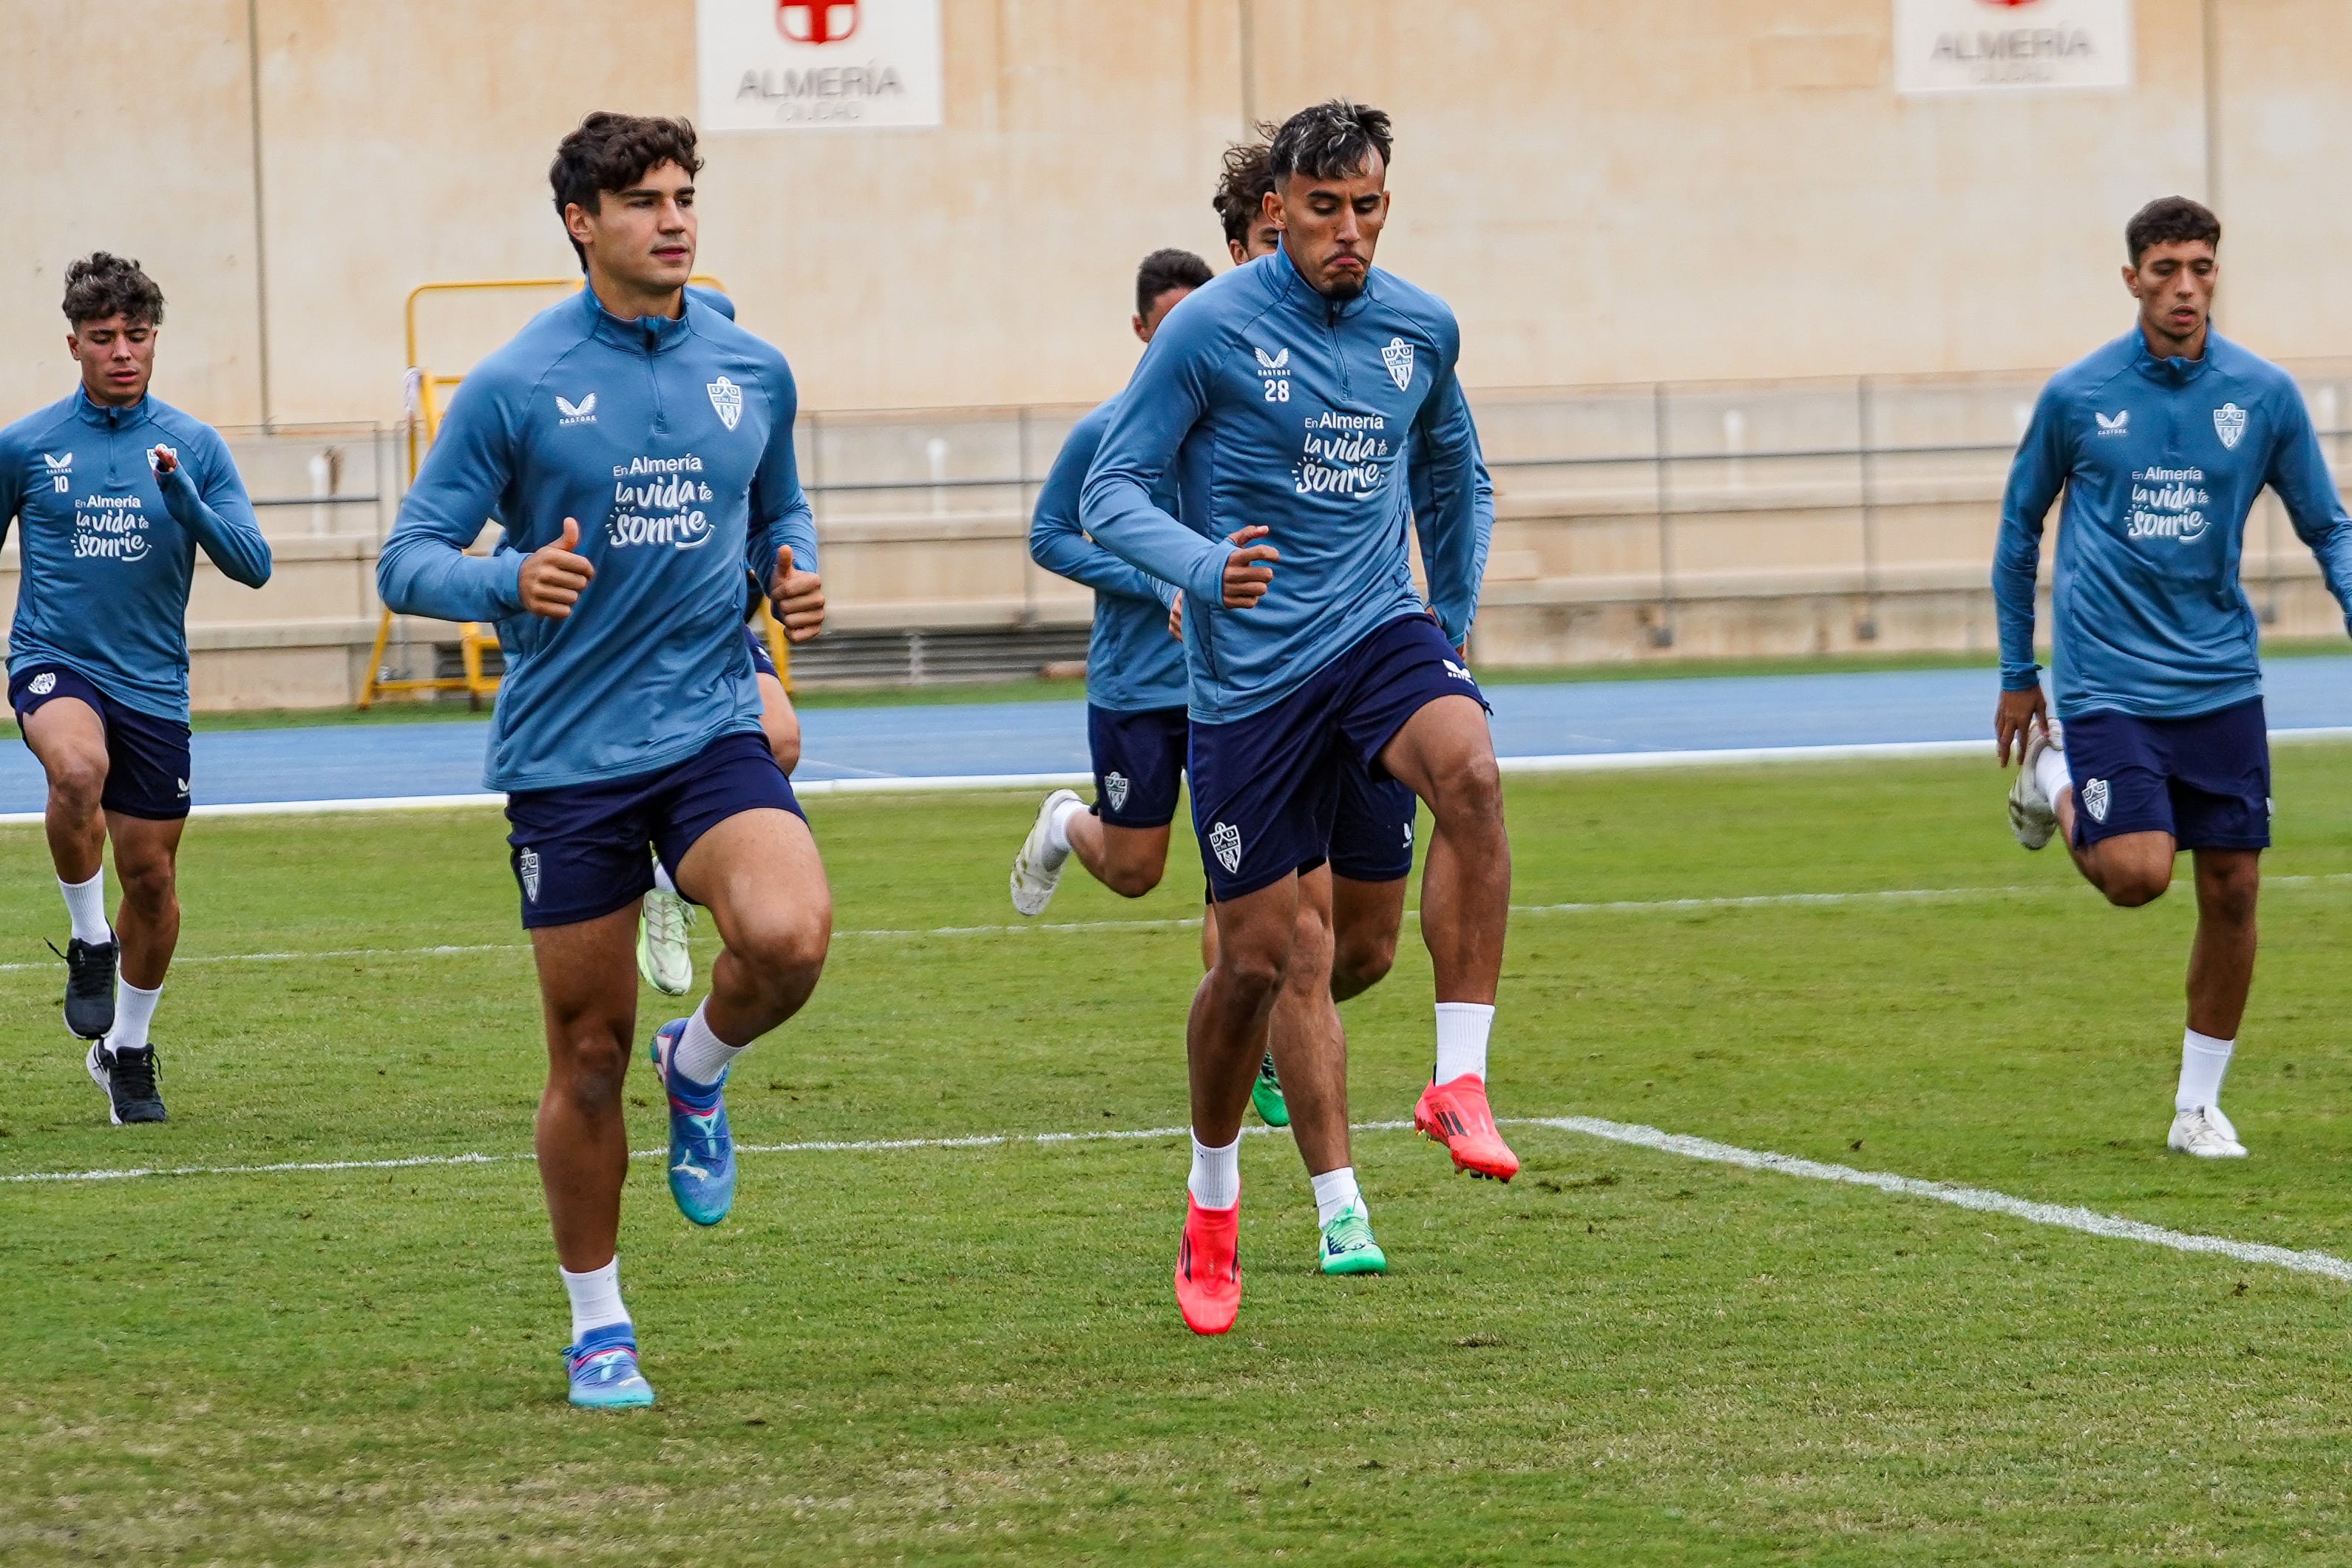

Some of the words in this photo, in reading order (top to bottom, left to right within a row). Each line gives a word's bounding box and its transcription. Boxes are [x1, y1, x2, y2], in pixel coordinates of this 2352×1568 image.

[736, 58, 906, 98] ALMERÍA
[1264, 379, 1289, 402] 28
[1305, 418, 1318, 428] En
[1319, 412, 1384, 429] Almería
[1304, 432, 1321, 453] la
[1324, 430, 1375, 462] vida
[613, 465, 628, 477] En
[629, 452, 703, 474] Almería
[2132, 471, 2143, 480] En
[2144, 466, 2203, 481] Almería
[53, 475, 69, 493] 10
[615, 482, 634, 503] la
[637, 474, 696, 508] vida
[698, 481, 714, 500] te
[2132, 483, 2148, 501] la
[2149, 482, 2197, 509] vida
[2197, 489, 2210, 503] te
[75, 499, 87, 508] En
[76, 510, 90, 526] la
[92, 508, 137, 533] vida
